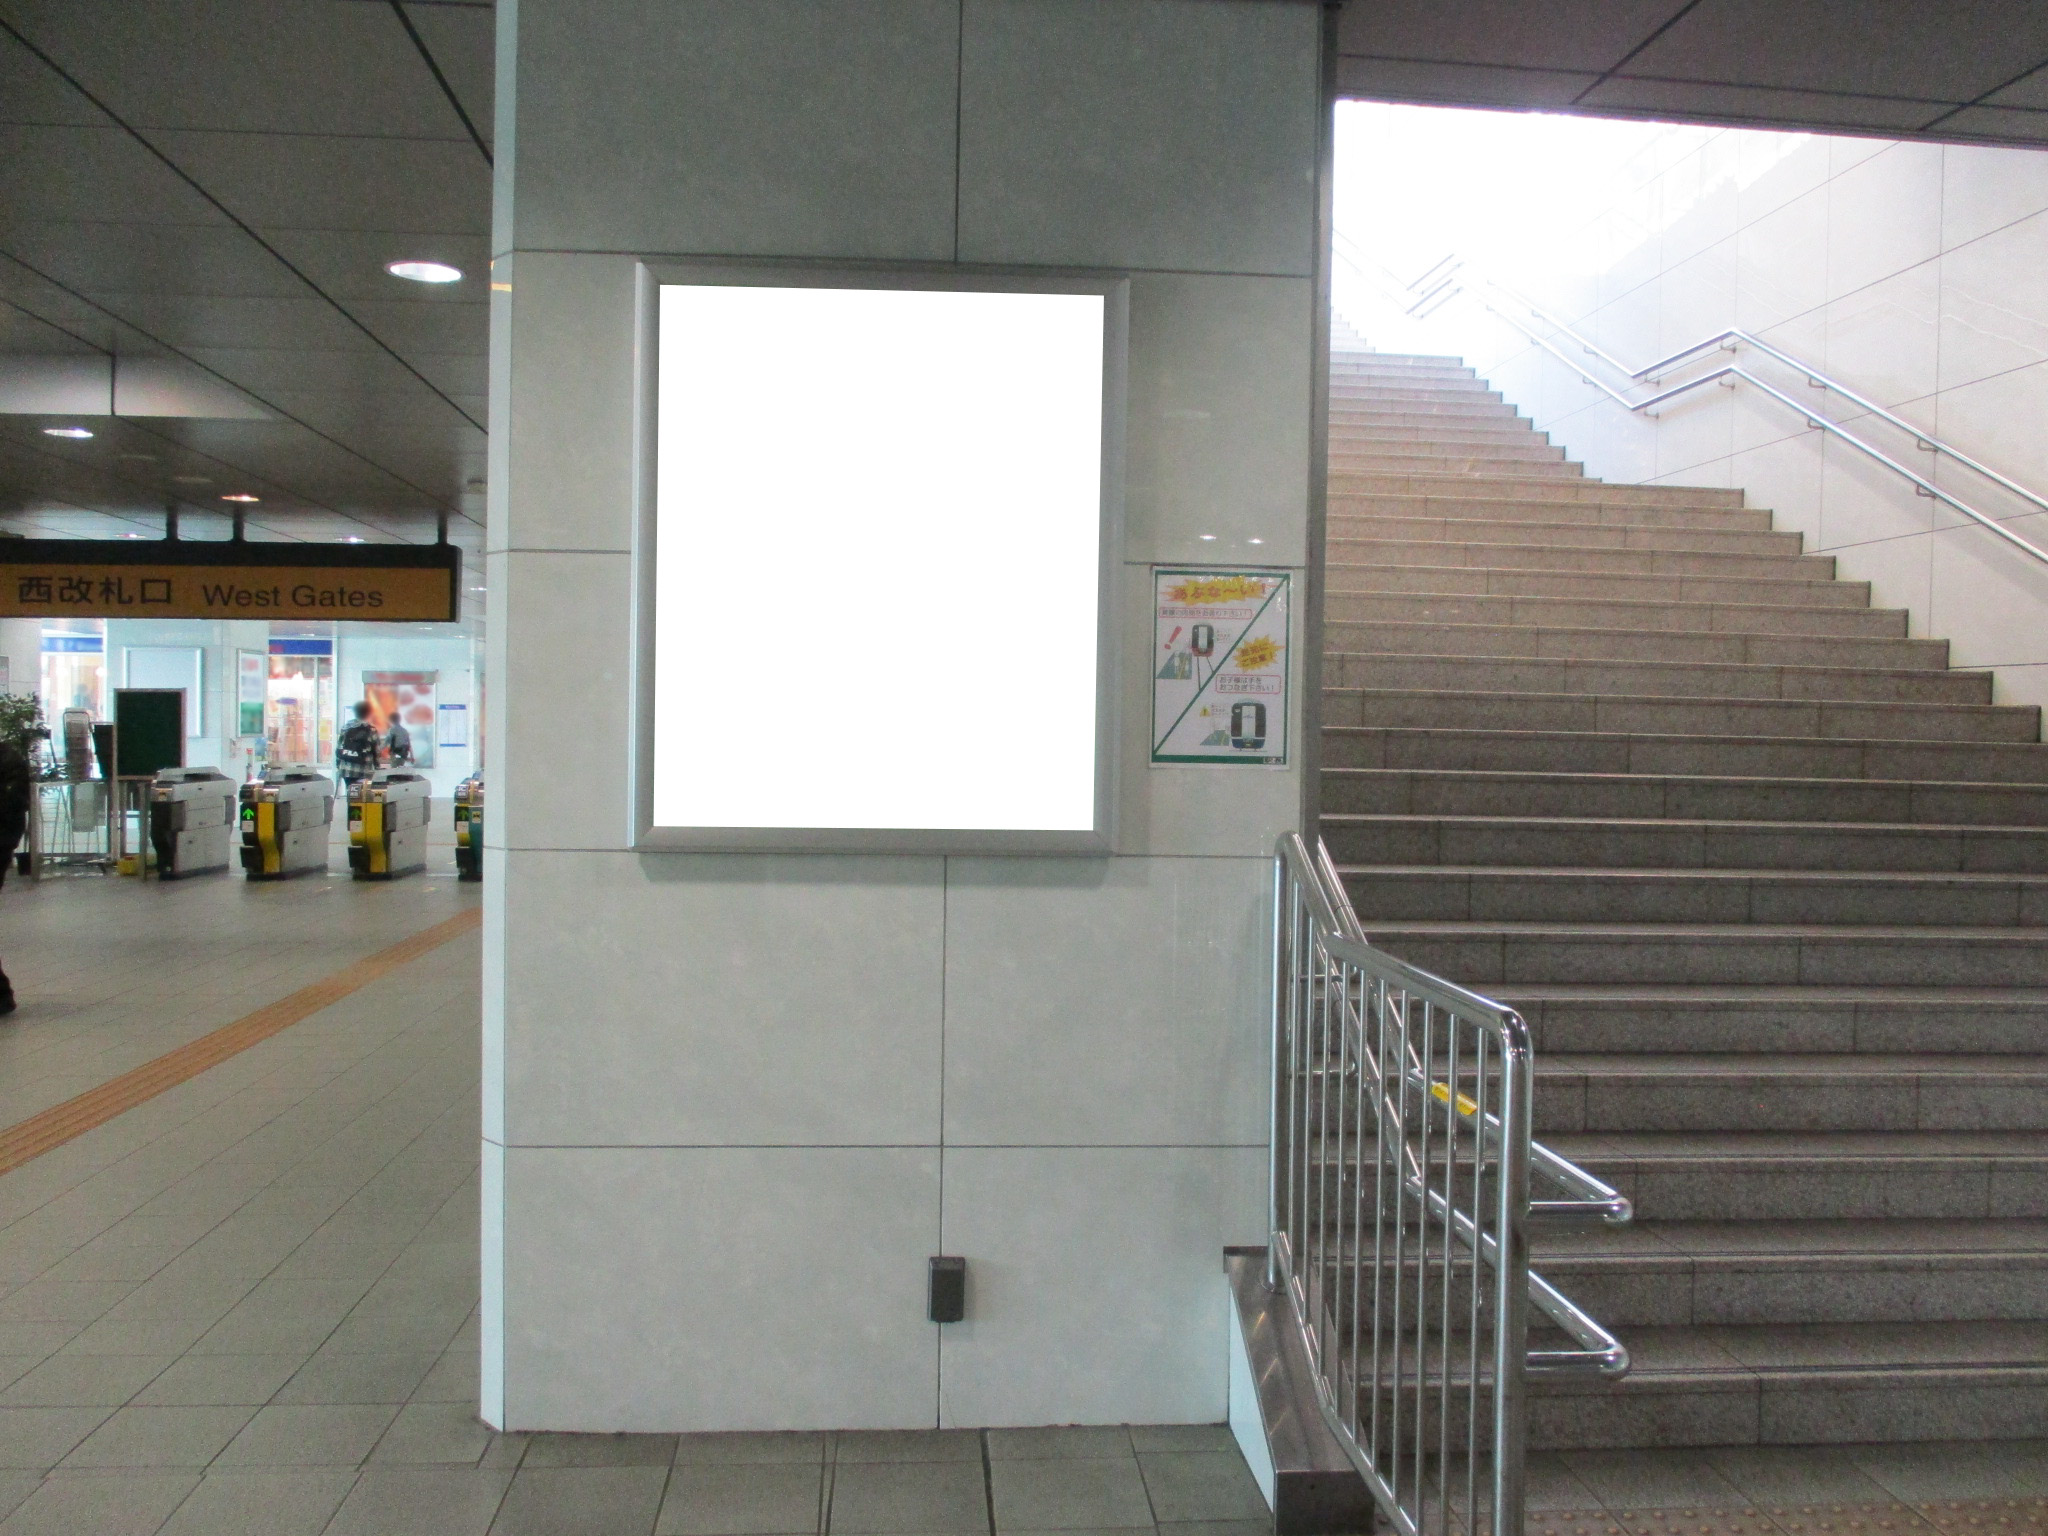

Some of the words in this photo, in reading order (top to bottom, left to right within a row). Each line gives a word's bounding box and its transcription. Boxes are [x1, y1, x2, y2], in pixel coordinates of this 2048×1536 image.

[18, 575, 173, 605] 西改札口
[202, 584, 279, 608] West
[291, 584, 384, 608] Gates
[342, 749, 359, 757] FILA
